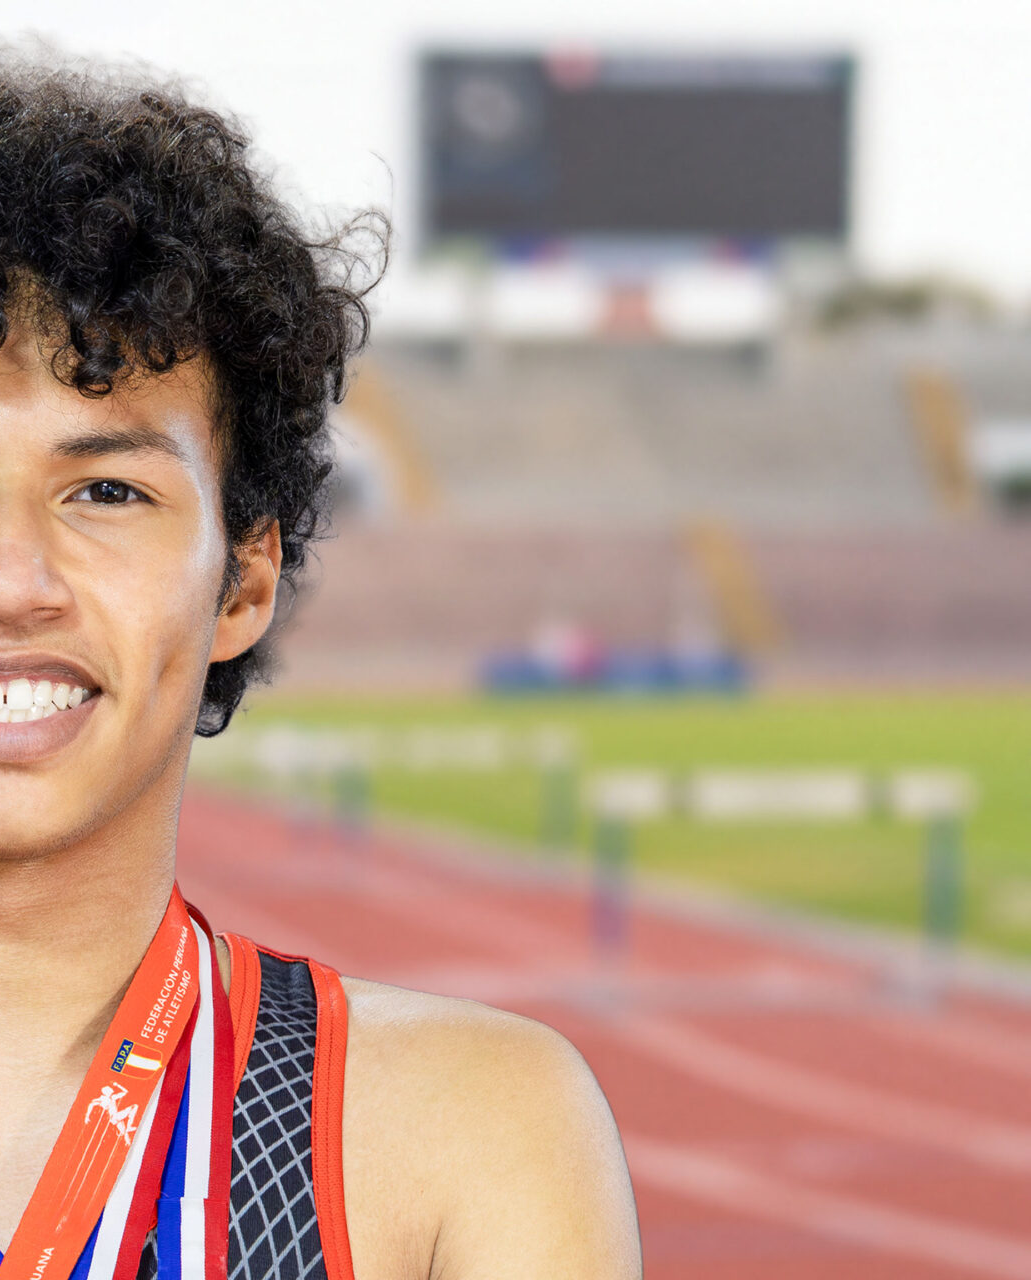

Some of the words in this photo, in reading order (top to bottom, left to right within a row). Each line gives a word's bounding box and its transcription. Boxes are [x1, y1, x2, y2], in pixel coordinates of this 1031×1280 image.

[140, 969, 179, 1039] FEDERACIÓN
[172, 925, 189, 971] PERUANA
[154, 1028, 169, 1044] DE
[162, 969, 191, 1028] ATLETISMO
